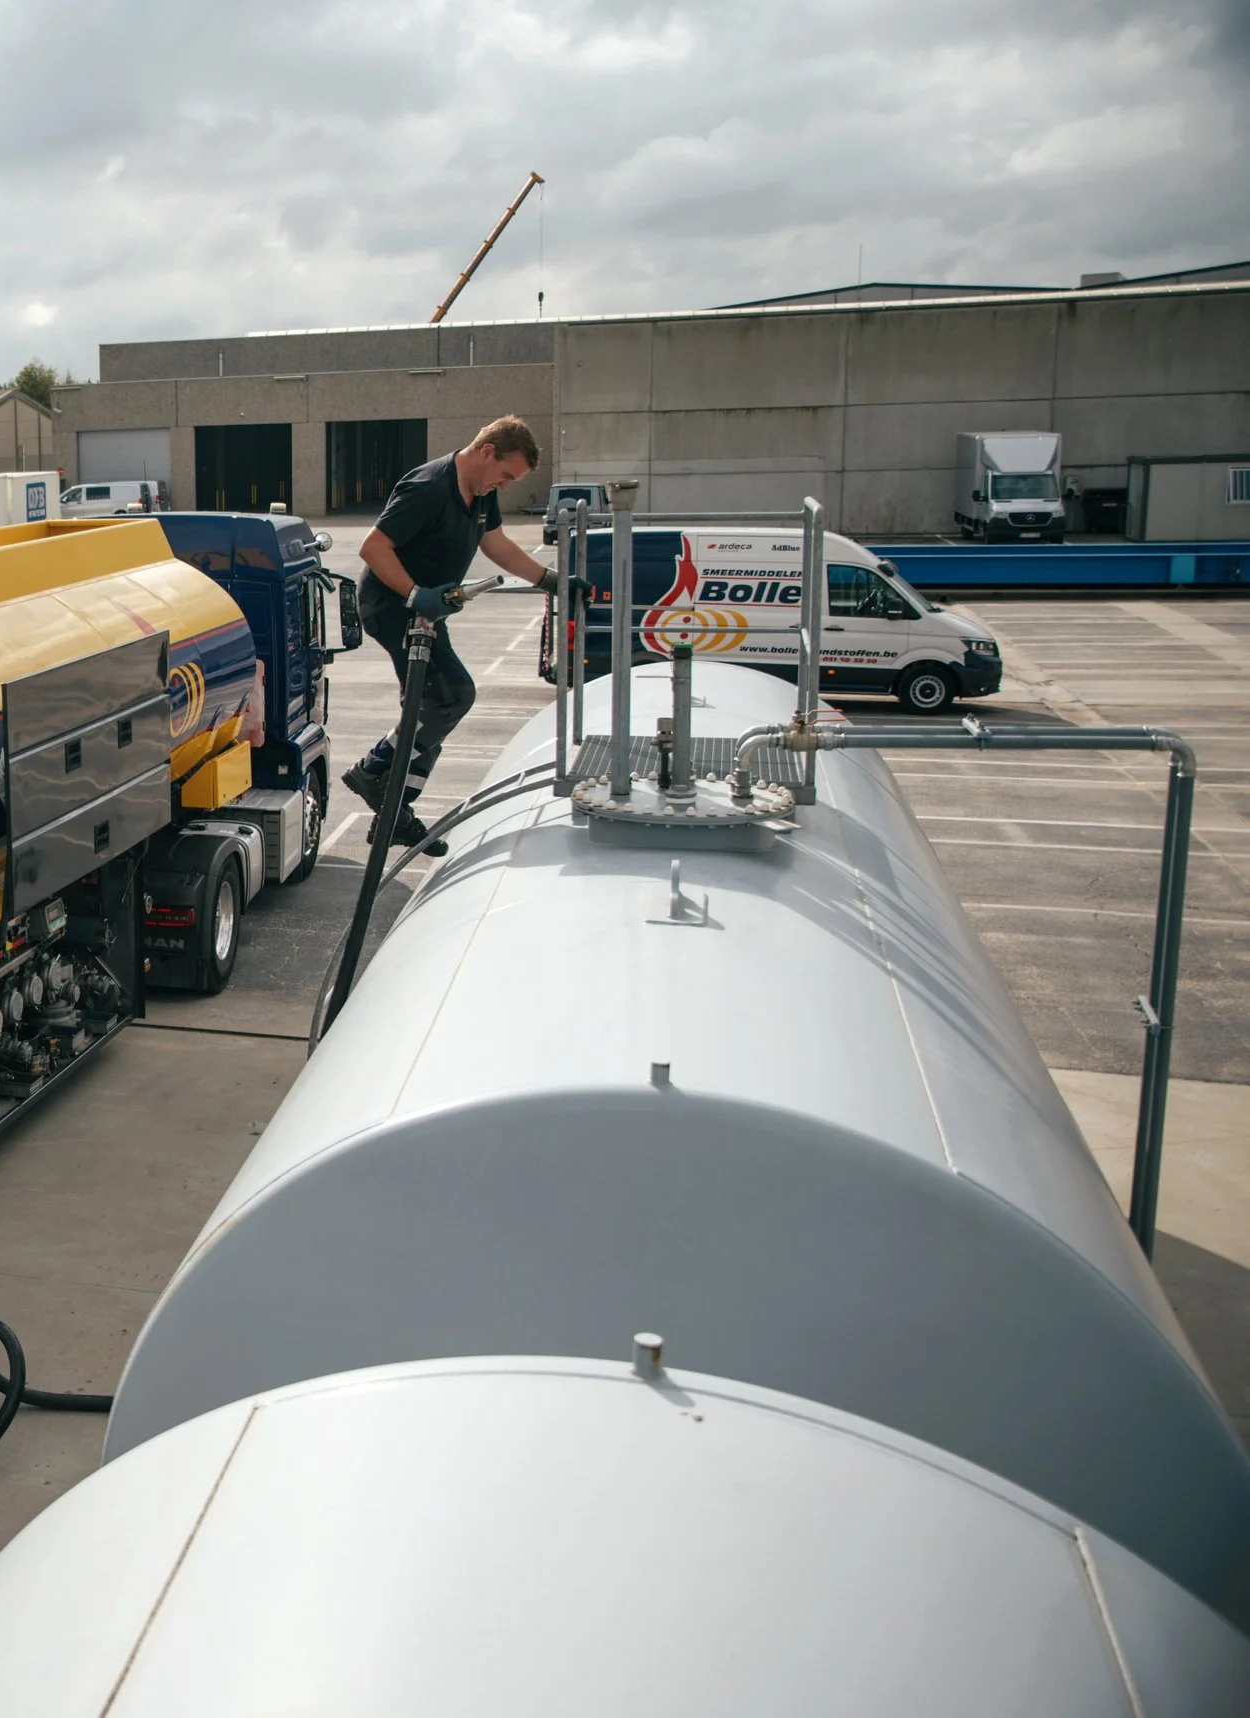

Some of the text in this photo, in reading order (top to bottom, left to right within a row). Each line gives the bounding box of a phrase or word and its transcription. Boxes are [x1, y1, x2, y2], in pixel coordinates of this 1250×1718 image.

[718, 542, 752, 550] ardeca
[771, 544, 801, 552] AdBlue
[698, 581, 803, 604] Bolle
[739, 645, 899, 658] www.bollendstoffen.be
